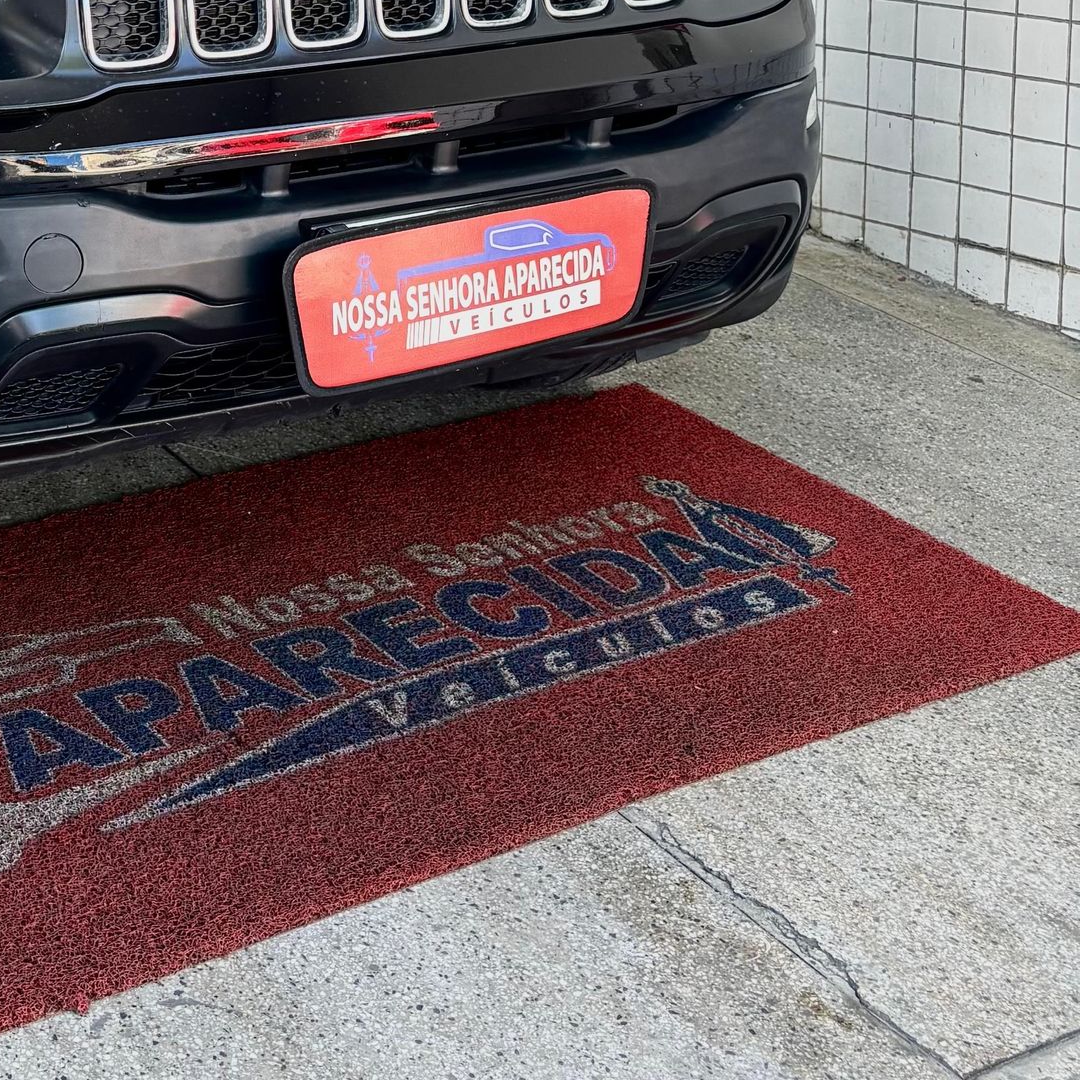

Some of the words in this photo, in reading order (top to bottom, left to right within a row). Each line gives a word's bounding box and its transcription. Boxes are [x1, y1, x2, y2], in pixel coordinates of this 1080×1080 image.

[331, 288, 403, 337] NOSSA
[405, 266, 501, 321] SENHORA
[502, 244, 607, 298] APARECIDA
[448, 287, 589, 336] VEÍCULOS
[188, 563, 416, 640] Nossa
[406, 500, 665, 576] Senhora
